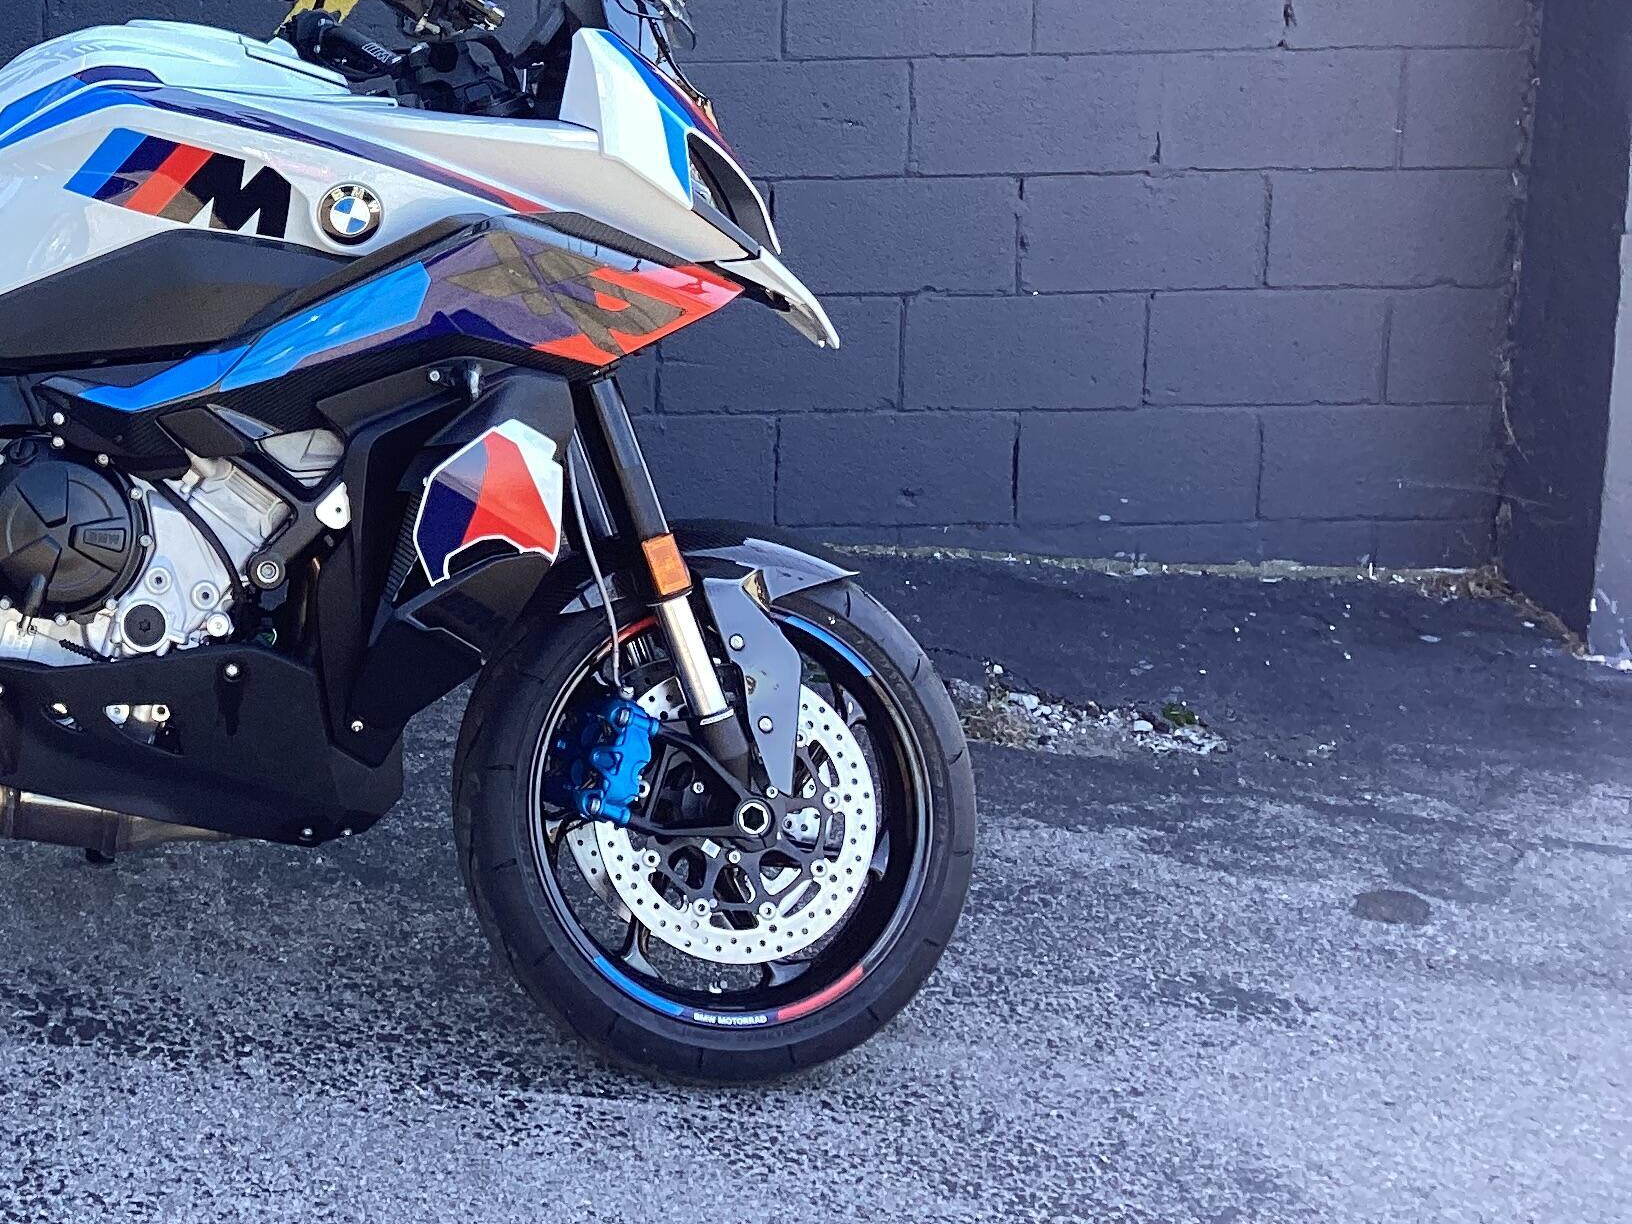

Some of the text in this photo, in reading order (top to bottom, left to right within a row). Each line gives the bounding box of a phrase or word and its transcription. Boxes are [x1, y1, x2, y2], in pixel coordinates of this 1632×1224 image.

[330, 186, 380, 213] BMW
[693, 1011, 768, 1026] BMW MOTORRAD
